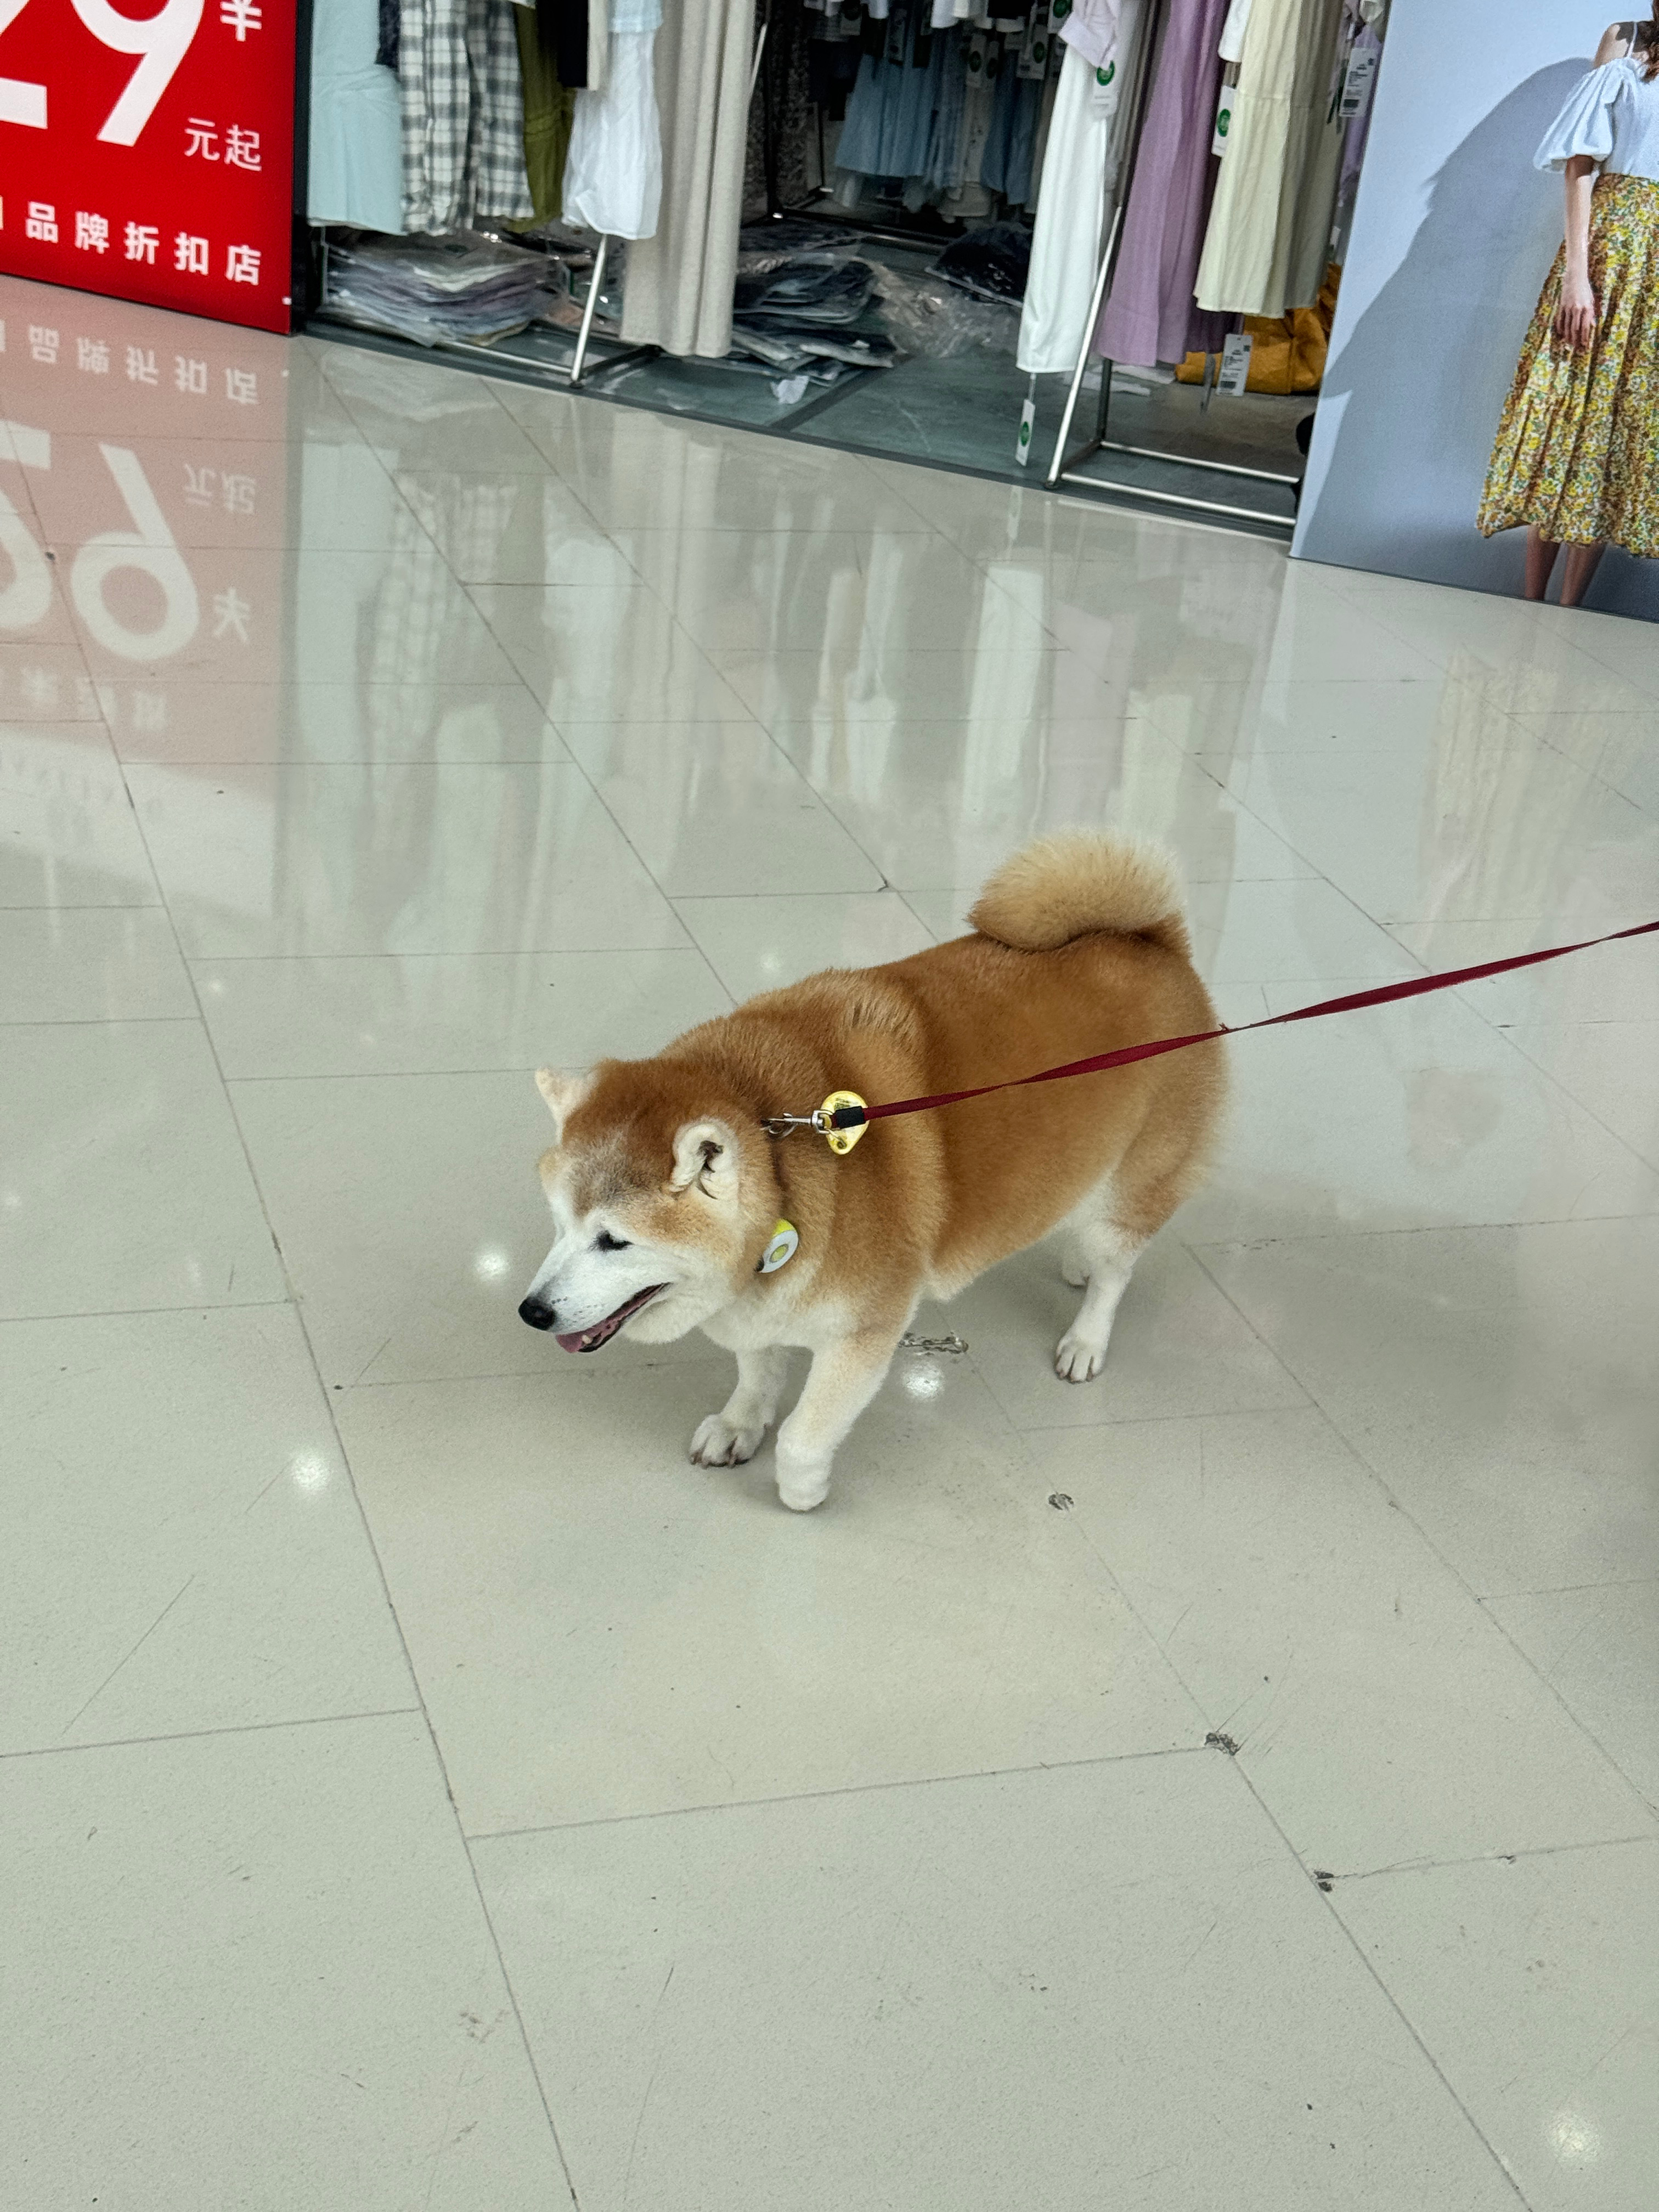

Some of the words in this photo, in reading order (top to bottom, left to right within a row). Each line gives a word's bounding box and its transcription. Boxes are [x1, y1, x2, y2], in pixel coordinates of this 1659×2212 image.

[185, 117, 262, 171] 元起
[0, 196, 261, 285] 品牌折扣店
